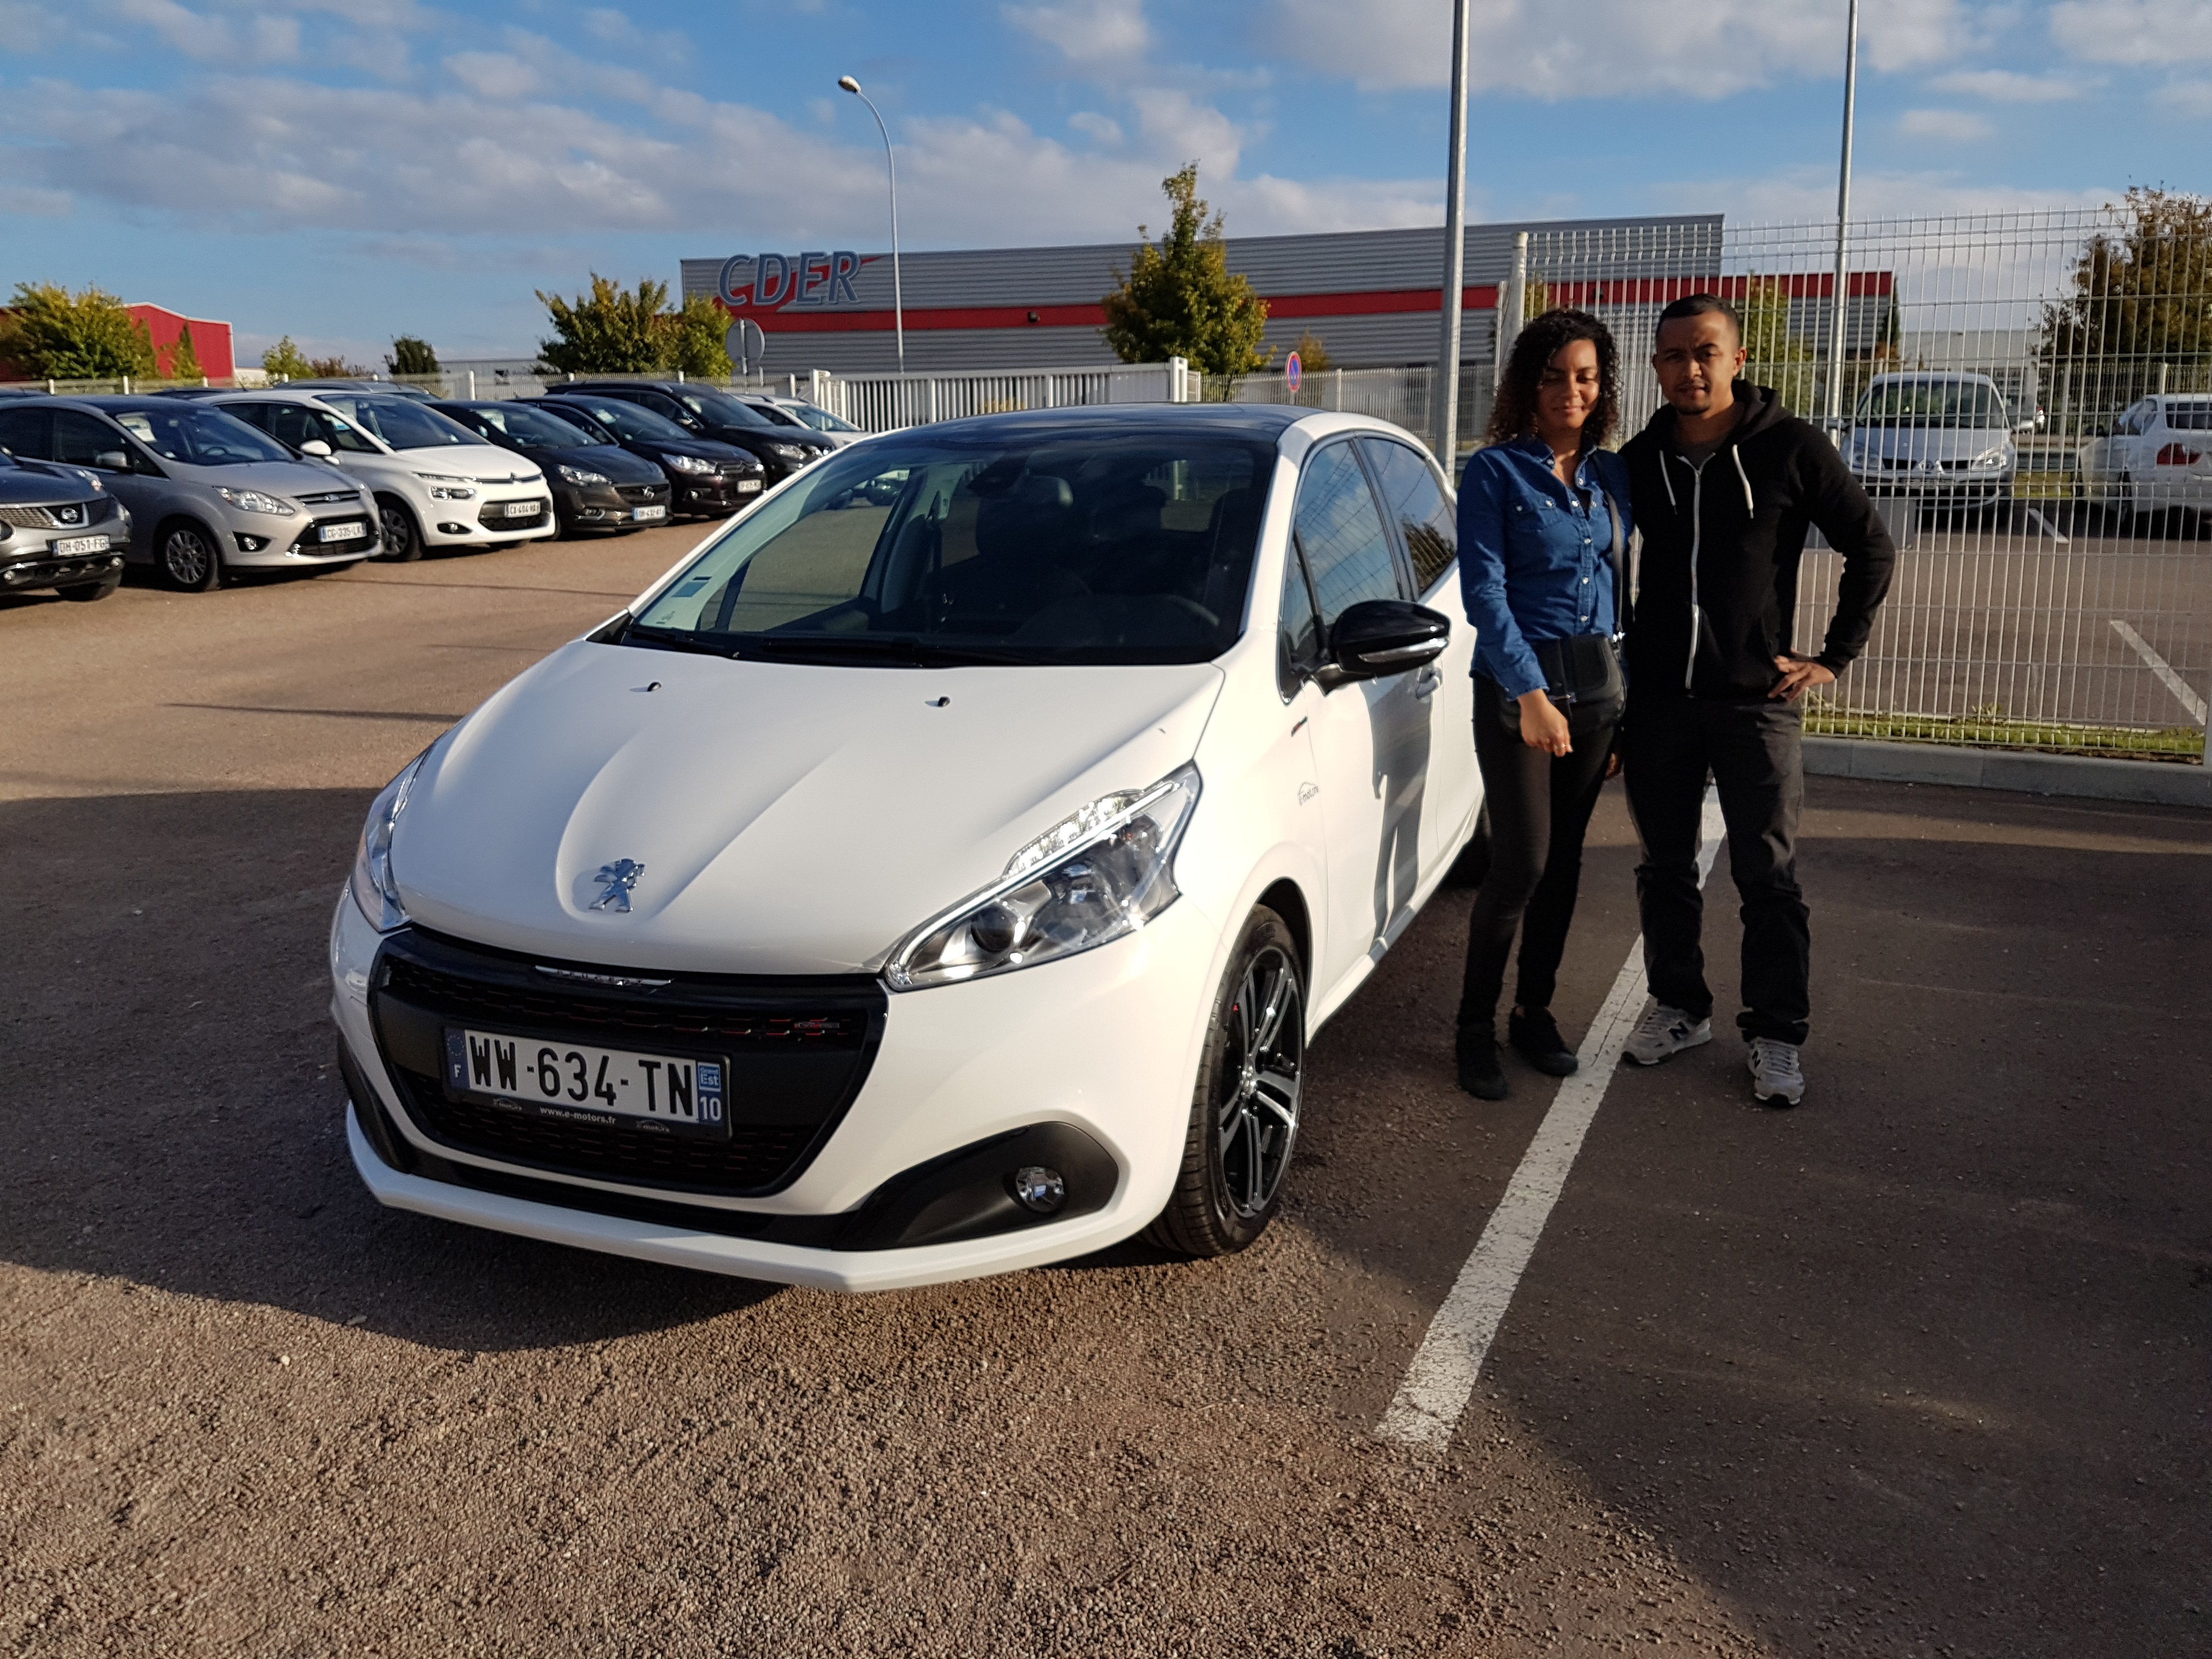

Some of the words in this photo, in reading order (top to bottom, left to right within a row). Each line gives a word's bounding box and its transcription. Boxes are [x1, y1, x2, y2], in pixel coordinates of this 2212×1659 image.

[719, 250, 861, 306] CDER
[454, 1063, 461, 1078] F
[470, 1035, 693, 1117] WW-634-TN
[701, 1073, 719, 1086] Est
[539, 1106, 617, 1124] www.e-motors.fr
[700, 1096, 721, 1121] 10
